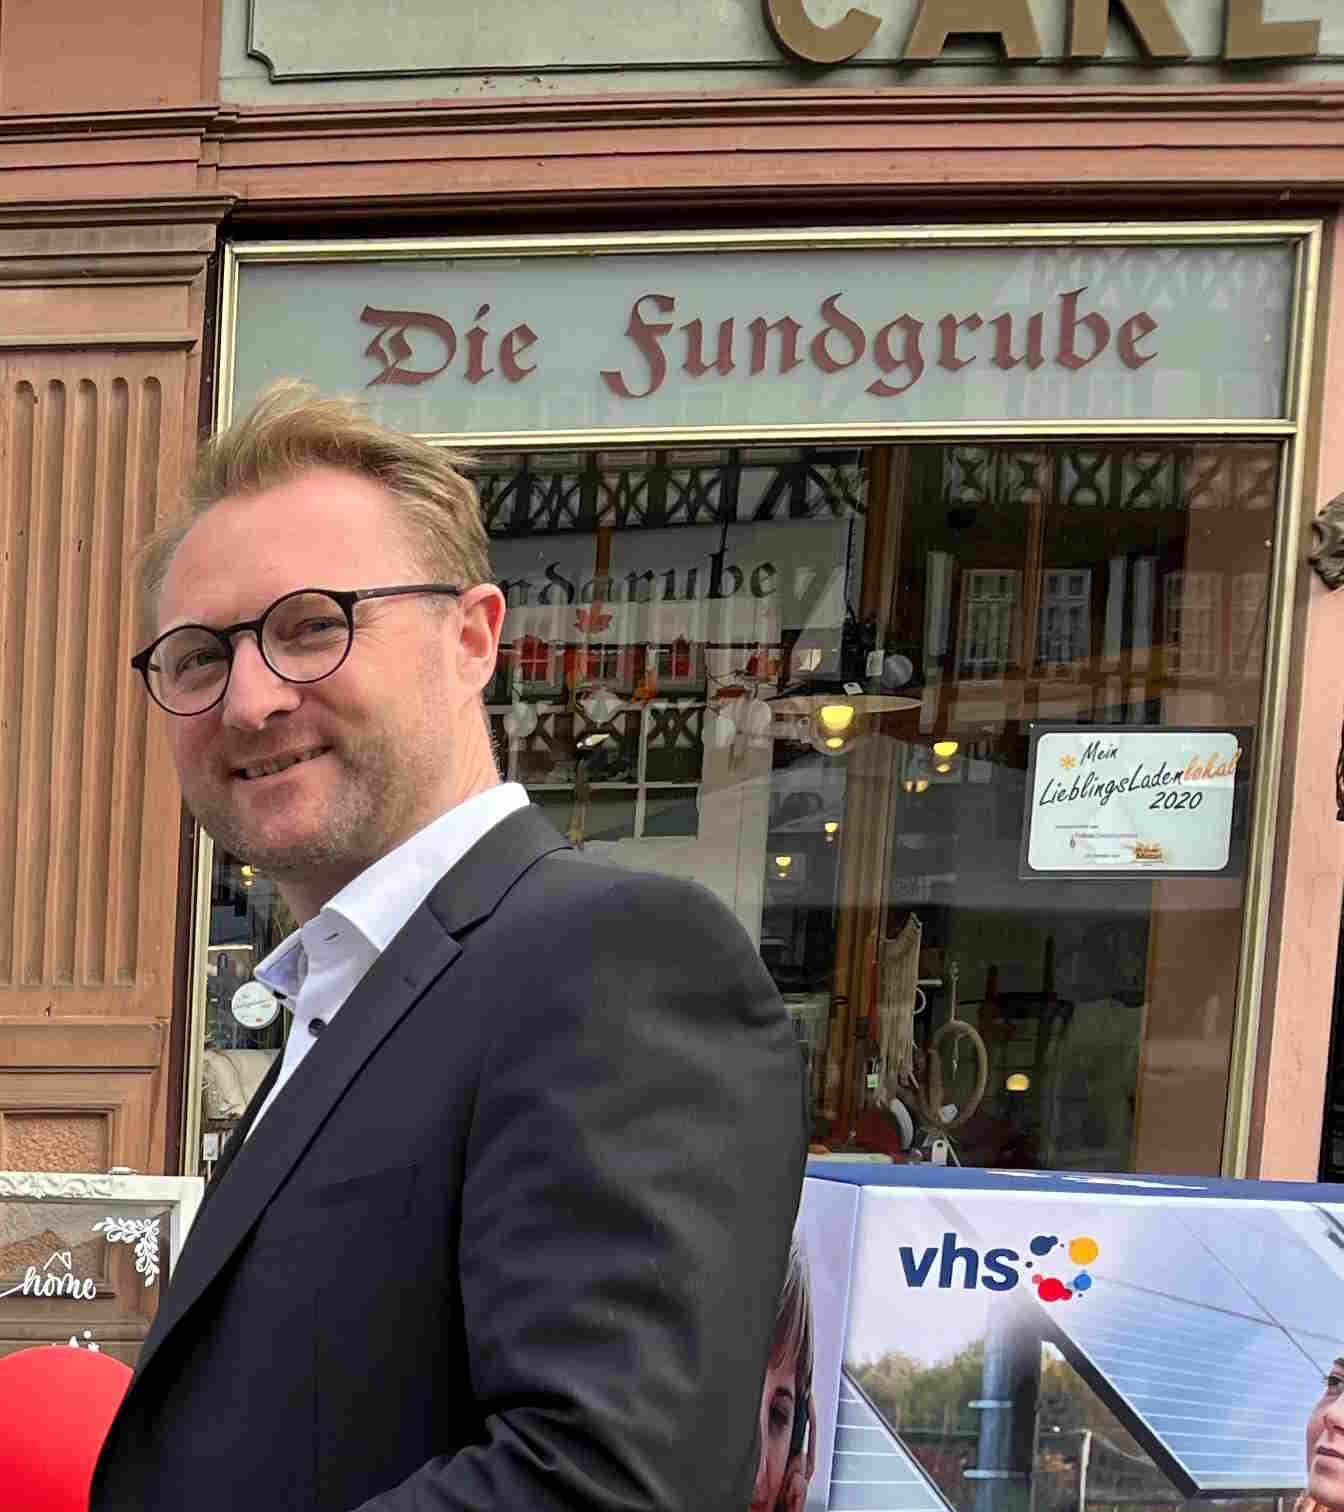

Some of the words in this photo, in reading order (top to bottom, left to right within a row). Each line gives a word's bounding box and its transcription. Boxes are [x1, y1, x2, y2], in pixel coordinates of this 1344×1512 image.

[358, 304, 540, 388] Die
[600, 286, 1160, 399] Fundgrube
[1079, 740, 1120, 766] Mein
[1148, 790, 1203, 811] 2020
[898, 1232, 1020, 1291] vhs
[21, 1265, 97, 1300] home
